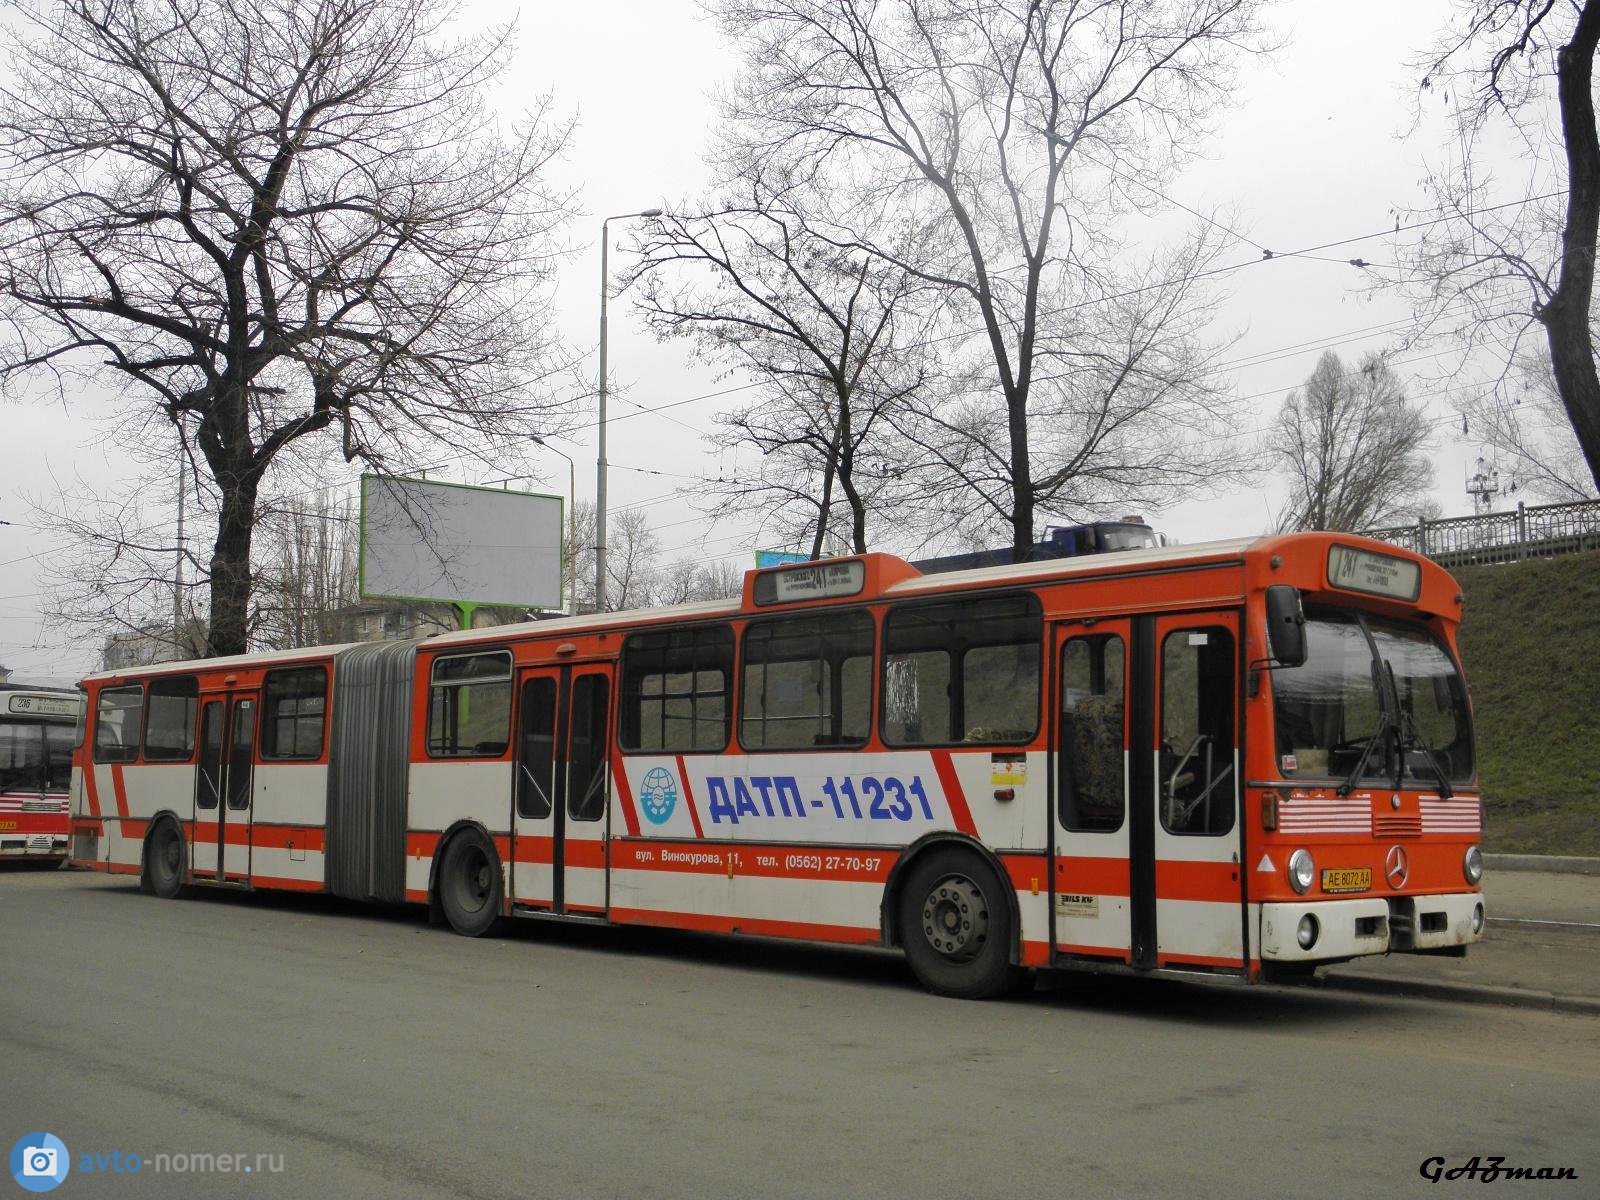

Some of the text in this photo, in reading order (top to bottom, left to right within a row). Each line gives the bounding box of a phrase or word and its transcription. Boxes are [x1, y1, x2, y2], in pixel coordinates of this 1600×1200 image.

[18, 698, 31, 708] 236
[635, 849, 881, 872] вул. Винокурова, 11, тел. (0562) 27-70-97
[1329, 871, 1370, 886] AE 8072 AA
